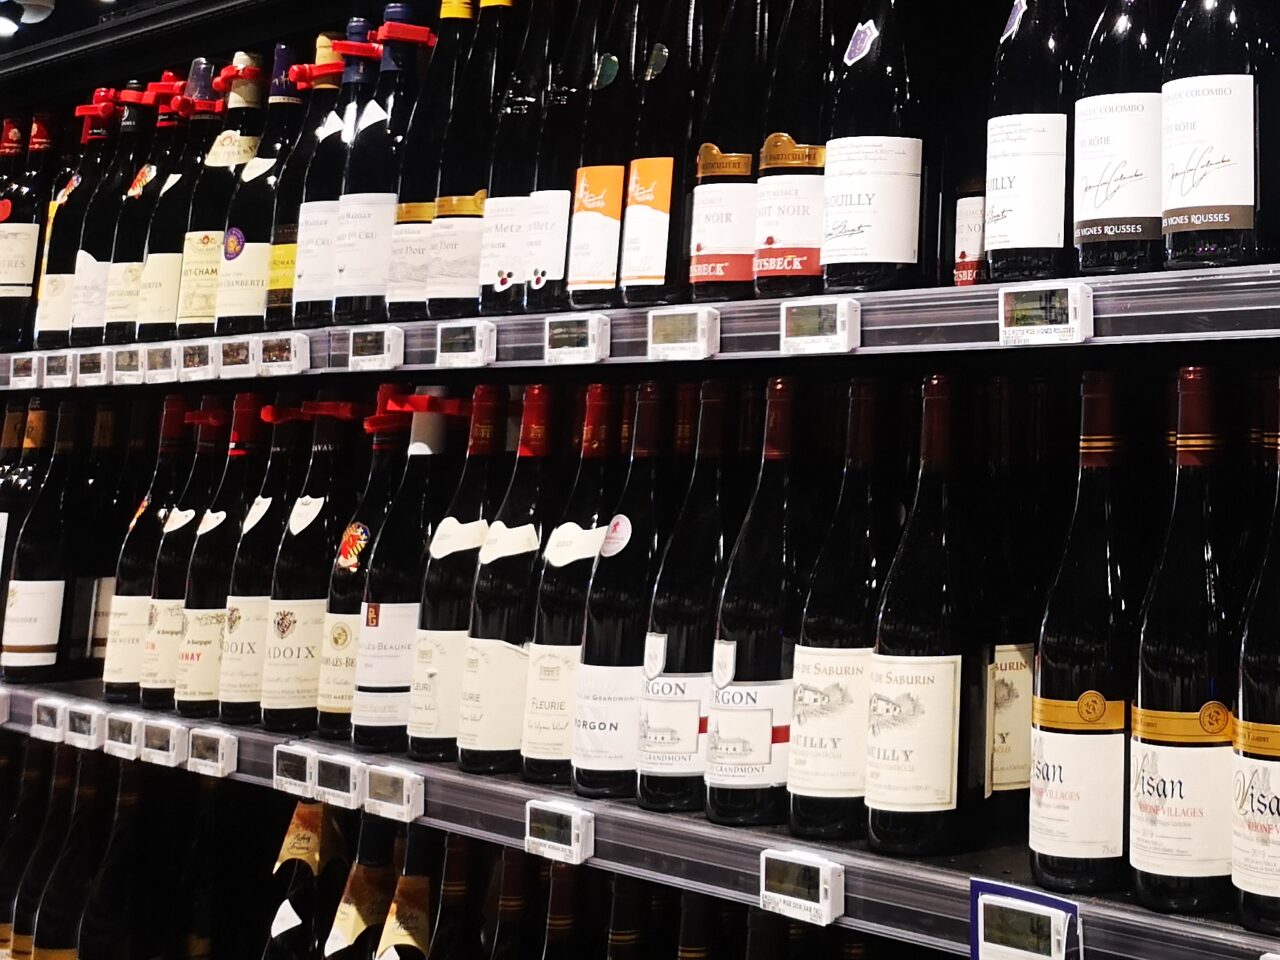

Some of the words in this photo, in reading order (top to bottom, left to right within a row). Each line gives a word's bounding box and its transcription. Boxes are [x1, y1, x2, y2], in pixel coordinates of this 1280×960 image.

[777, 204, 811, 217] NOIR
[704, 212, 733, 224] NOIR
[1168, 215, 1189, 225] VIGNES
[1190, 212, 1231, 224] ROUSSES
[1081, 225, 1103, 236] VIGNES
[1104, 223, 1142, 235] ROUSSES
[813, 662, 865, 677] SABURIN
[885, 670, 936, 686] SABURIN
[531, 700, 566, 713] FLEURIE
[714, 764, 766, 775] GRANDMONT
[1032, 759, 1064, 784] isan
[1160, 806, 1204, 819] VILLAGES
